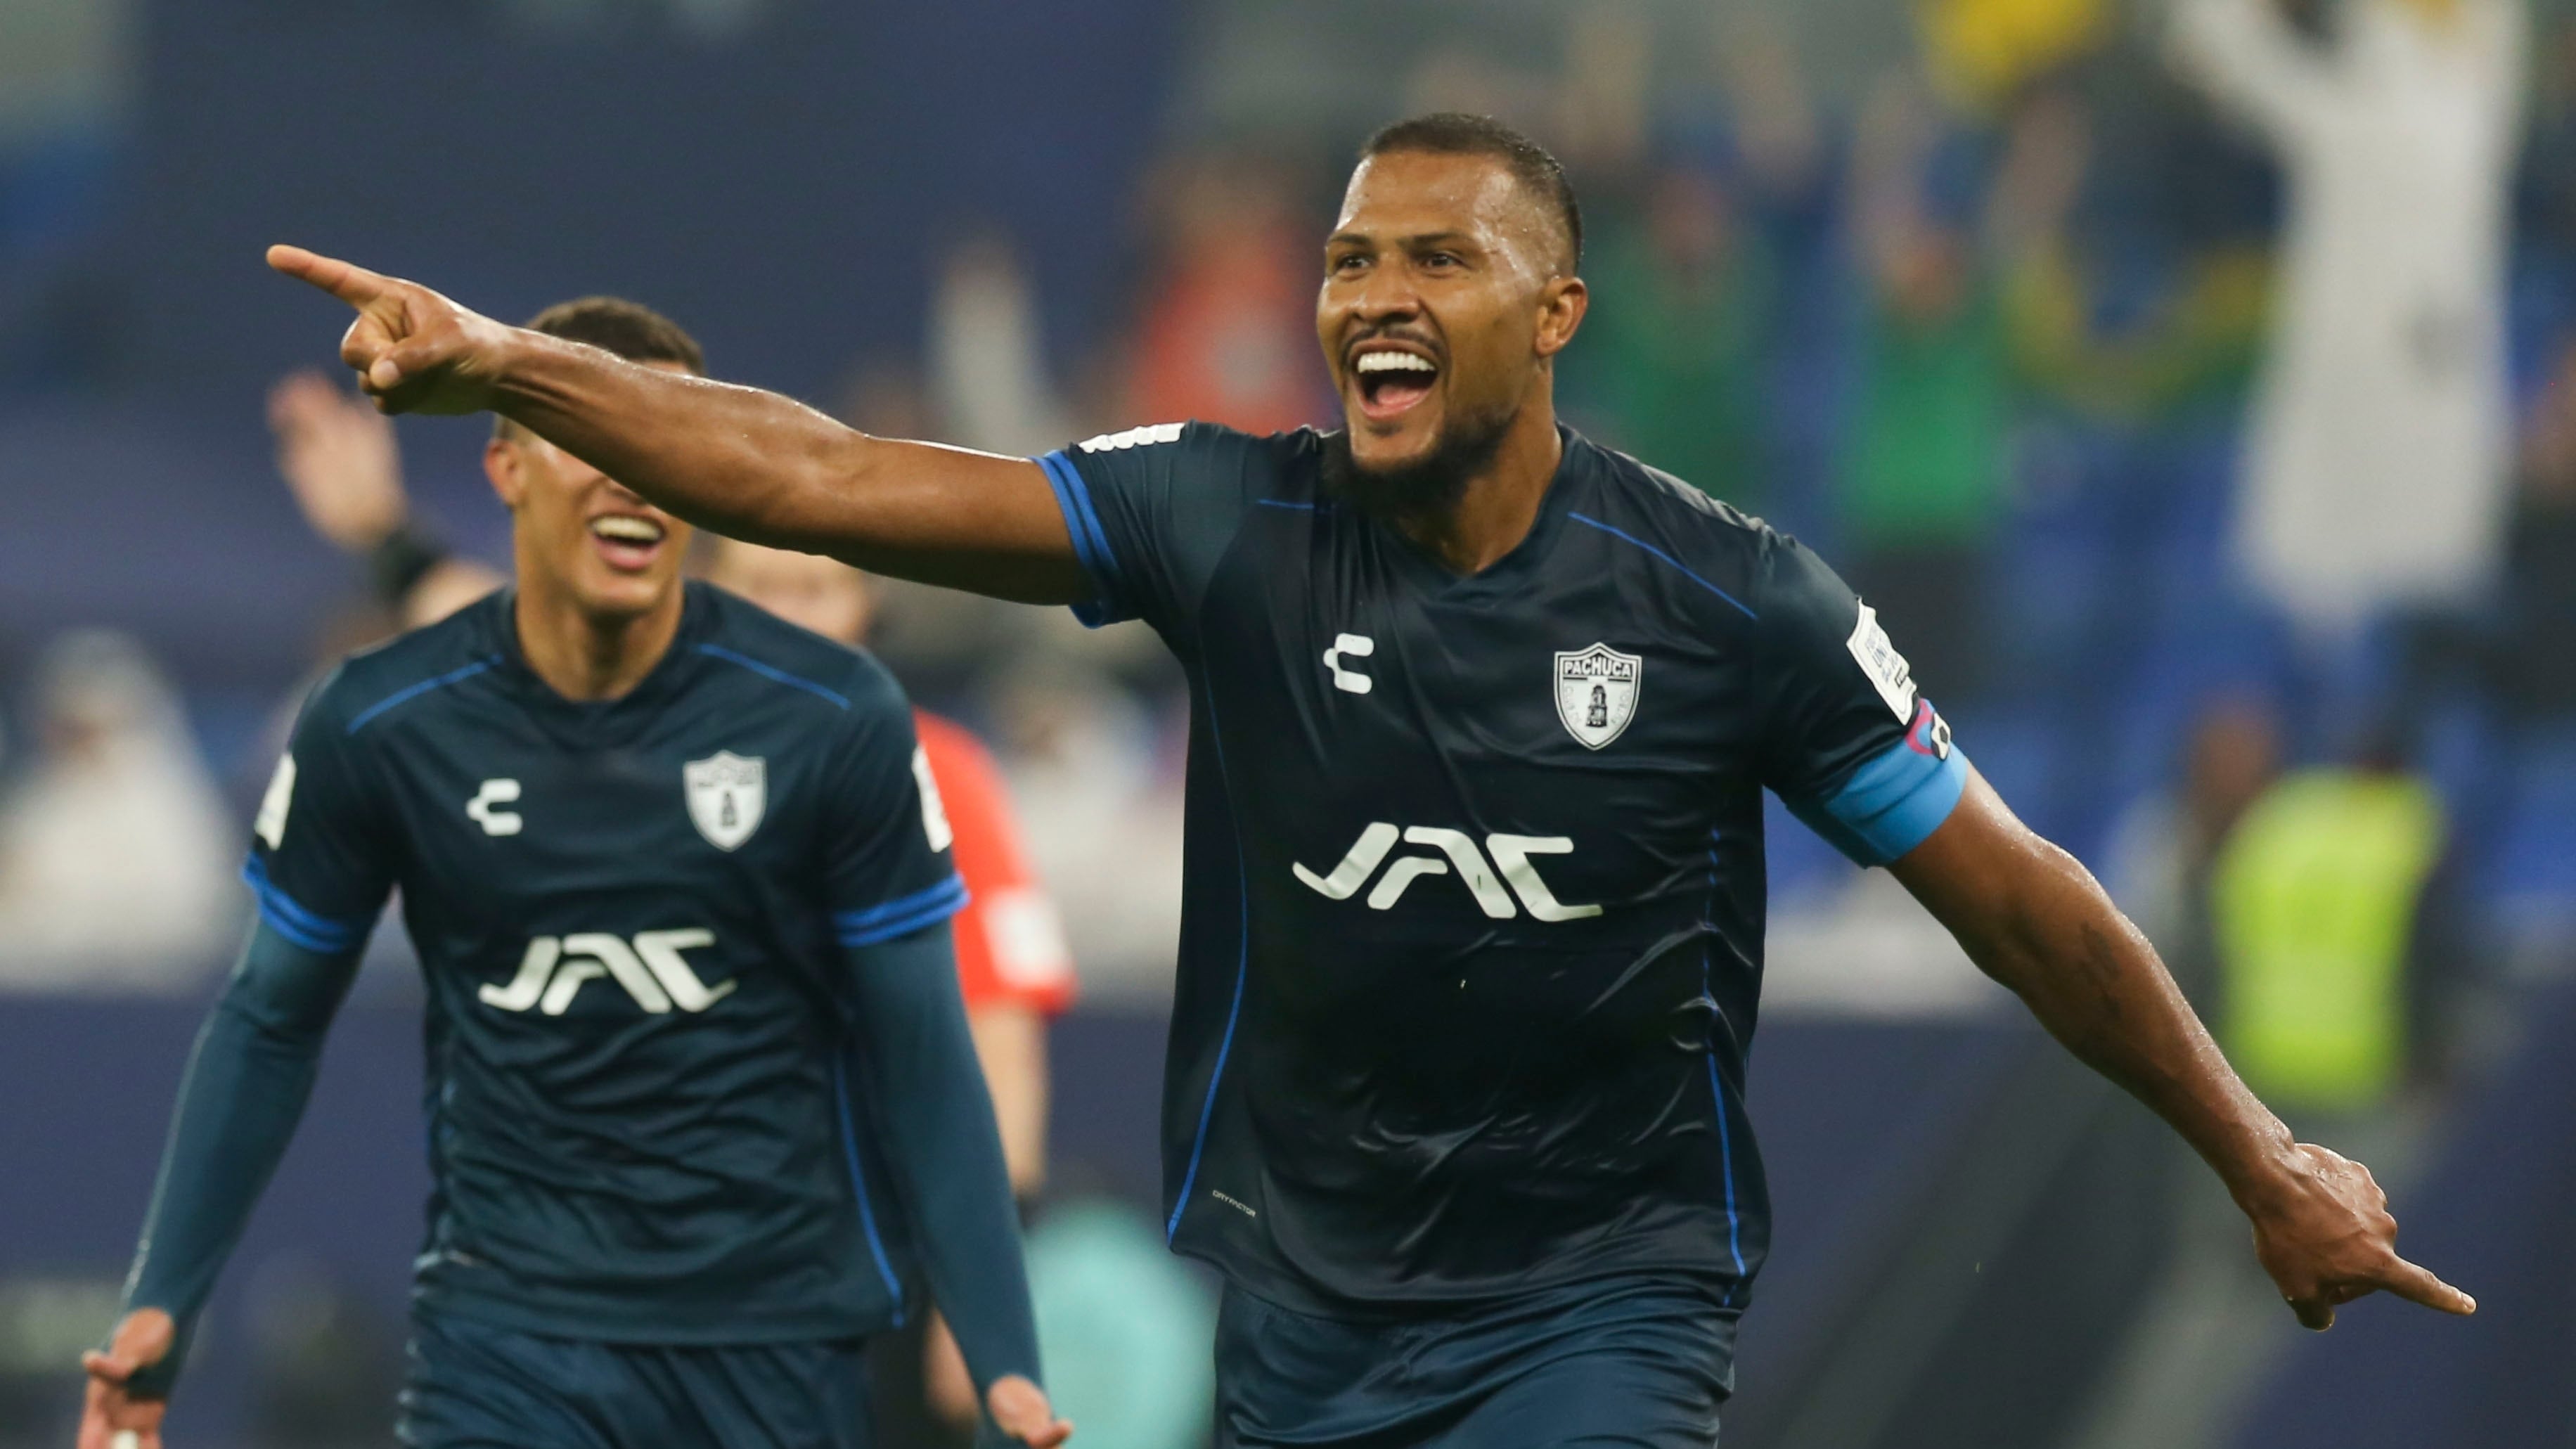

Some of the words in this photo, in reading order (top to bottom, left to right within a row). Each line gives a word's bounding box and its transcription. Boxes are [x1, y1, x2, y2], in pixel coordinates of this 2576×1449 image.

[1564, 656, 1631, 676] PACHUCA
[1292, 822, 1603, 922] JAC
[478, 927, 738, 1015] JAC
